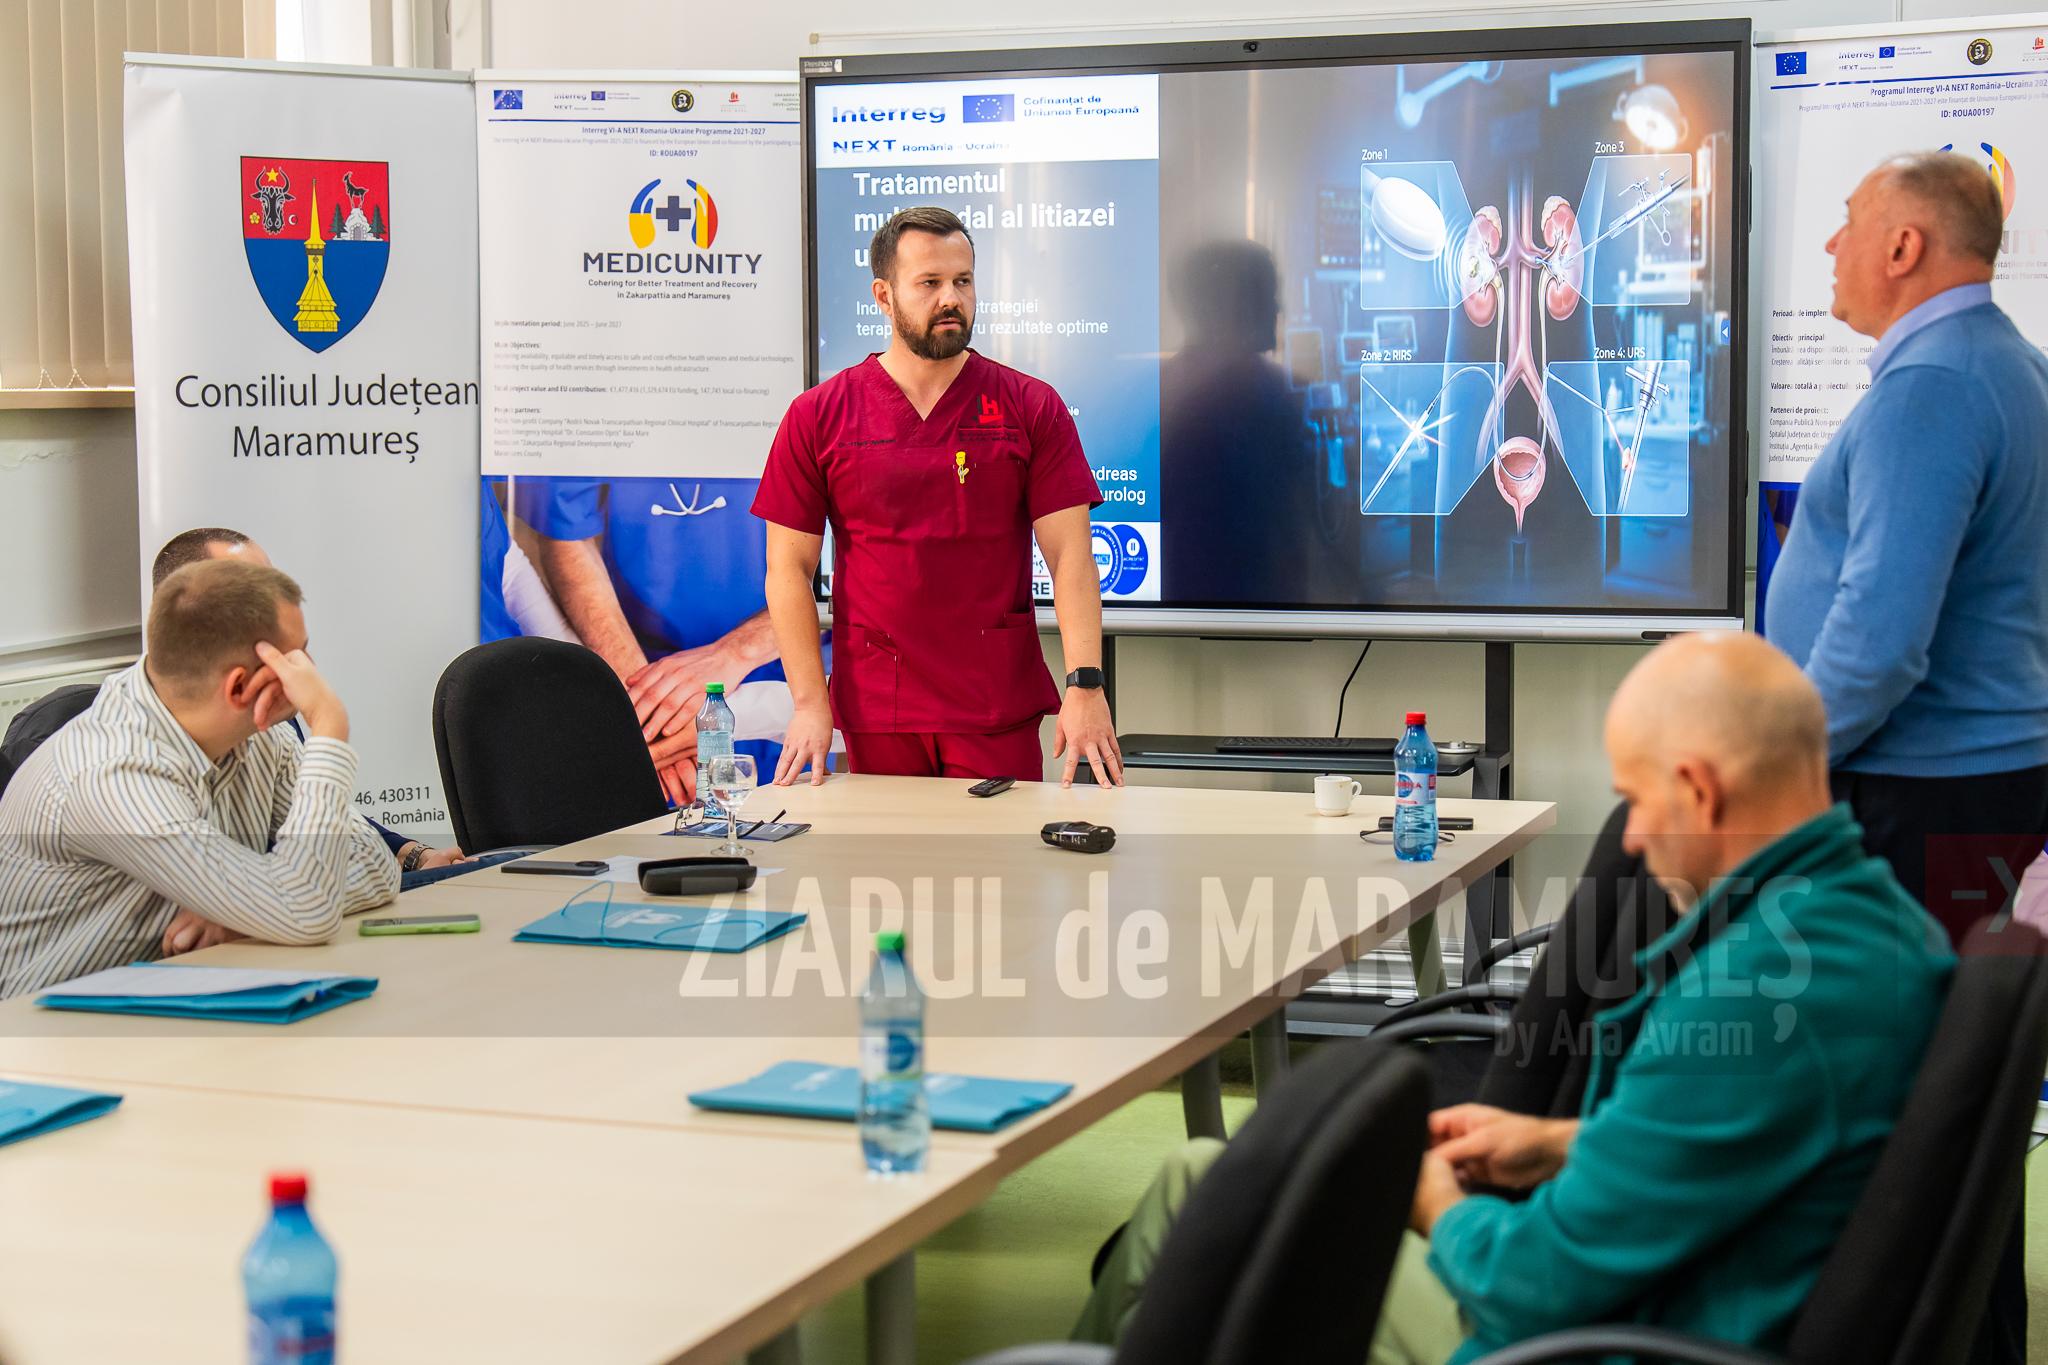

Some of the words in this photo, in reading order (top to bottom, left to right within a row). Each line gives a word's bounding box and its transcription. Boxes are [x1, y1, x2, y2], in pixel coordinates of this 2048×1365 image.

[1871, 87, 1905, 98] Programul
[1907, 85, 1935, 95] Interreg
[1936, 84, 1950, 93] VI-A
[1951, 83, 1968, 92] NEXT
[1087, 95, 1102, 104] de
[832, 106, 947, 124] Interreg
[1941, 109, 1951, 118] ID:
[1952, 107, 1995, 118] ROUA00197
[582, 126, 607, 136] Interreg
[640, 127, 694, 135] Romania-Ukraine
[695, 128, 732, 137] Programme
[832, 139, 897, 154] NEXT
[1595, 141, 1617, 153] Zone
[1618, 141, 1624, 152] 3
[649, 149, 658, 157] ID:
[1361, 149, 1383, 160] Zone
[1384, 148, 1388, 160] 1
[853, 168, 1006, 196] Tratamentul
[1001, 203, 1023, 228] al
[1031, 202, 1116, 228] litiazei
[583, 252, 762, 274] MEDICUNITY
[588, 278, 623, 288] Cohering
[625, 279, 636, 287] for
[637, 279, 662, 287] Better
[665, 280, 704, 288] Treatment
[706, 280, 720, 288] and
[722, 281, 758, 289] Recovery
[626, 292, 670, 300] Zakarpattia
[1772, 309, 1795, 318] Perioad
[989, 320, 1053, 335] rezultate
[1057, 320, 1109, 338] optime
[1772, 334, 1794, 342] Obiectiv
[1361, 350, 1382, 361] Zone
[1383, 350, 1390, 360] 2:
[1392, 349, 1412, 361] RIRS
[1593, 348, 1616, 359] Zone
[1617, 347, 1626, 358] 4:
[1627, 347, 1646, 358] URS
[175, 373, 318, 409] Consiliul
[327, 373, 479, 415] Județean
[1795, 406, 1803, 414] de
[233, 424, 420, 464] Maramureș
[354, 790, 376, 807] 46,
[379, 786, 430, 803] 430311
[382, 807, 445, 825] România
